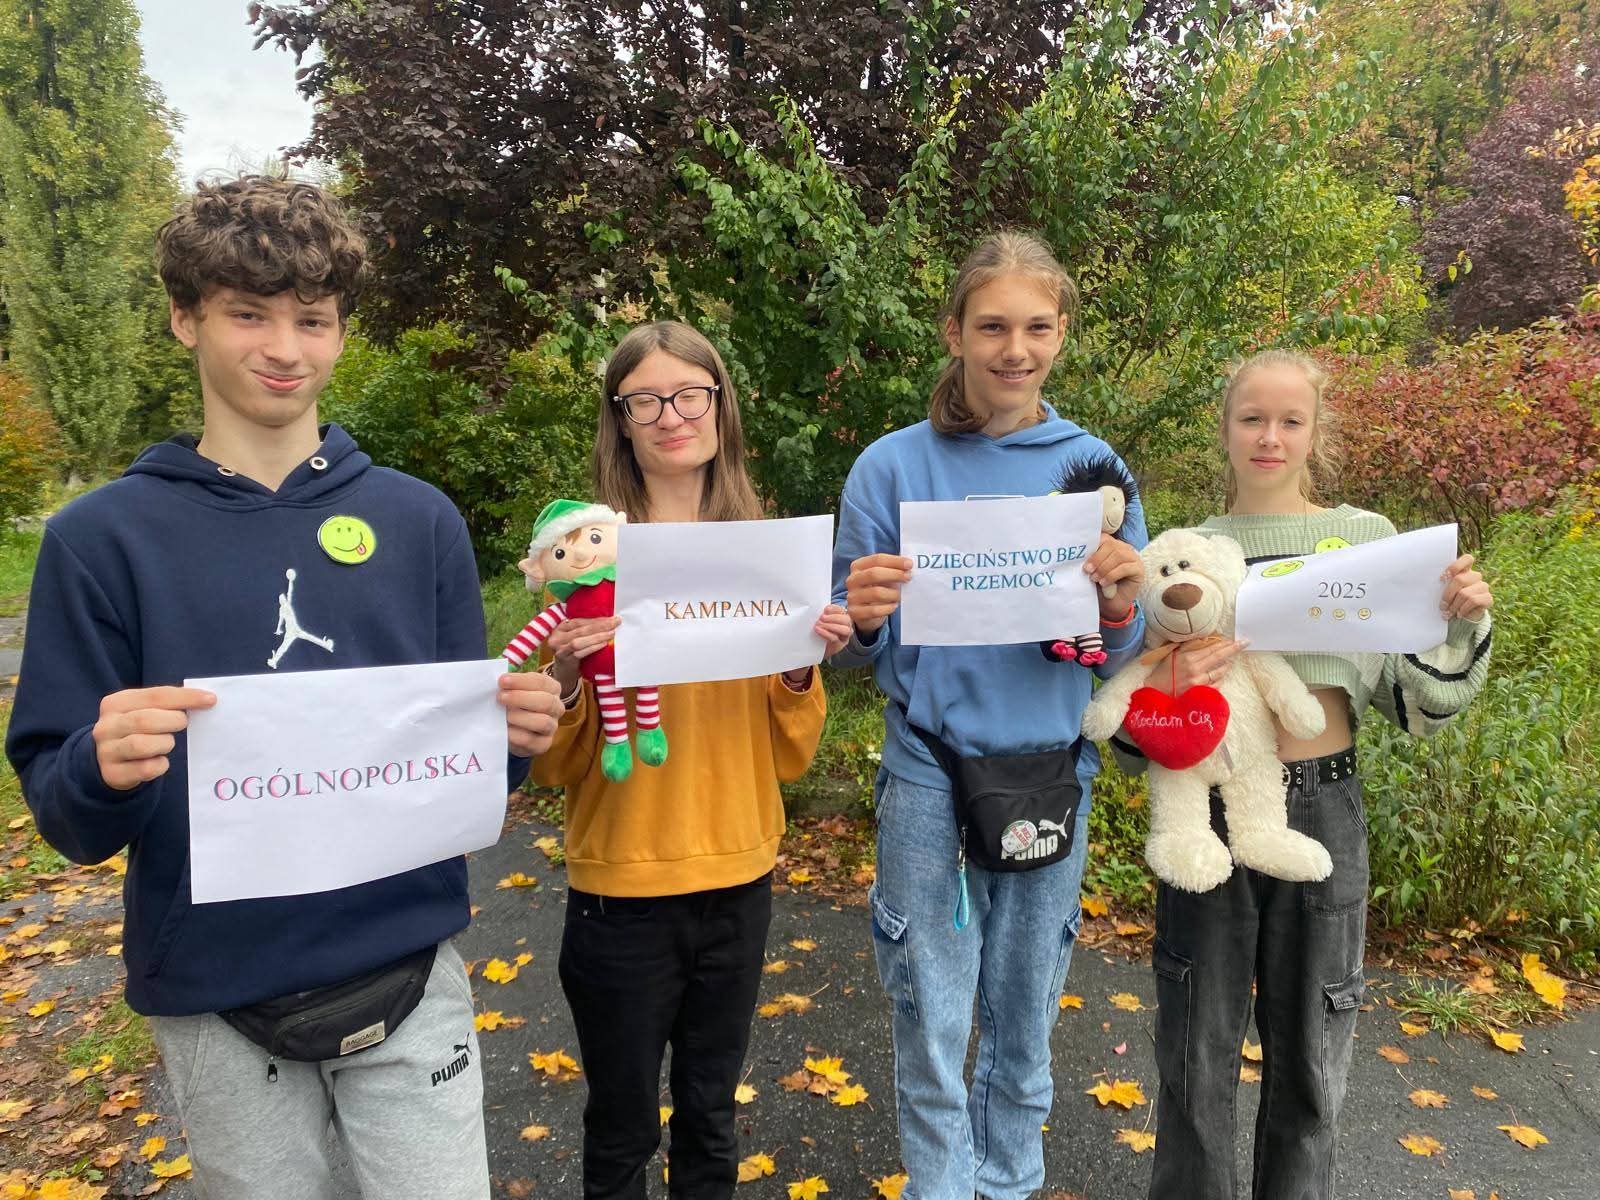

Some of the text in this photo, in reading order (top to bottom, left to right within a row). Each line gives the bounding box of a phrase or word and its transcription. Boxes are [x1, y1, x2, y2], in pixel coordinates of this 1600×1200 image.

[917, 544, 1087, 569] DZIECIŃSTWO BEZ
[951, 570, 1056, 591] PRZEMOCY
[1318, 581, 1367, 599] 2025
[664, 600, 790, 620] KAMPANIA
[213, 750, 484, 801] OGÓLNOPOLSKA
[430, 1052, 470, 1087] PUMA
